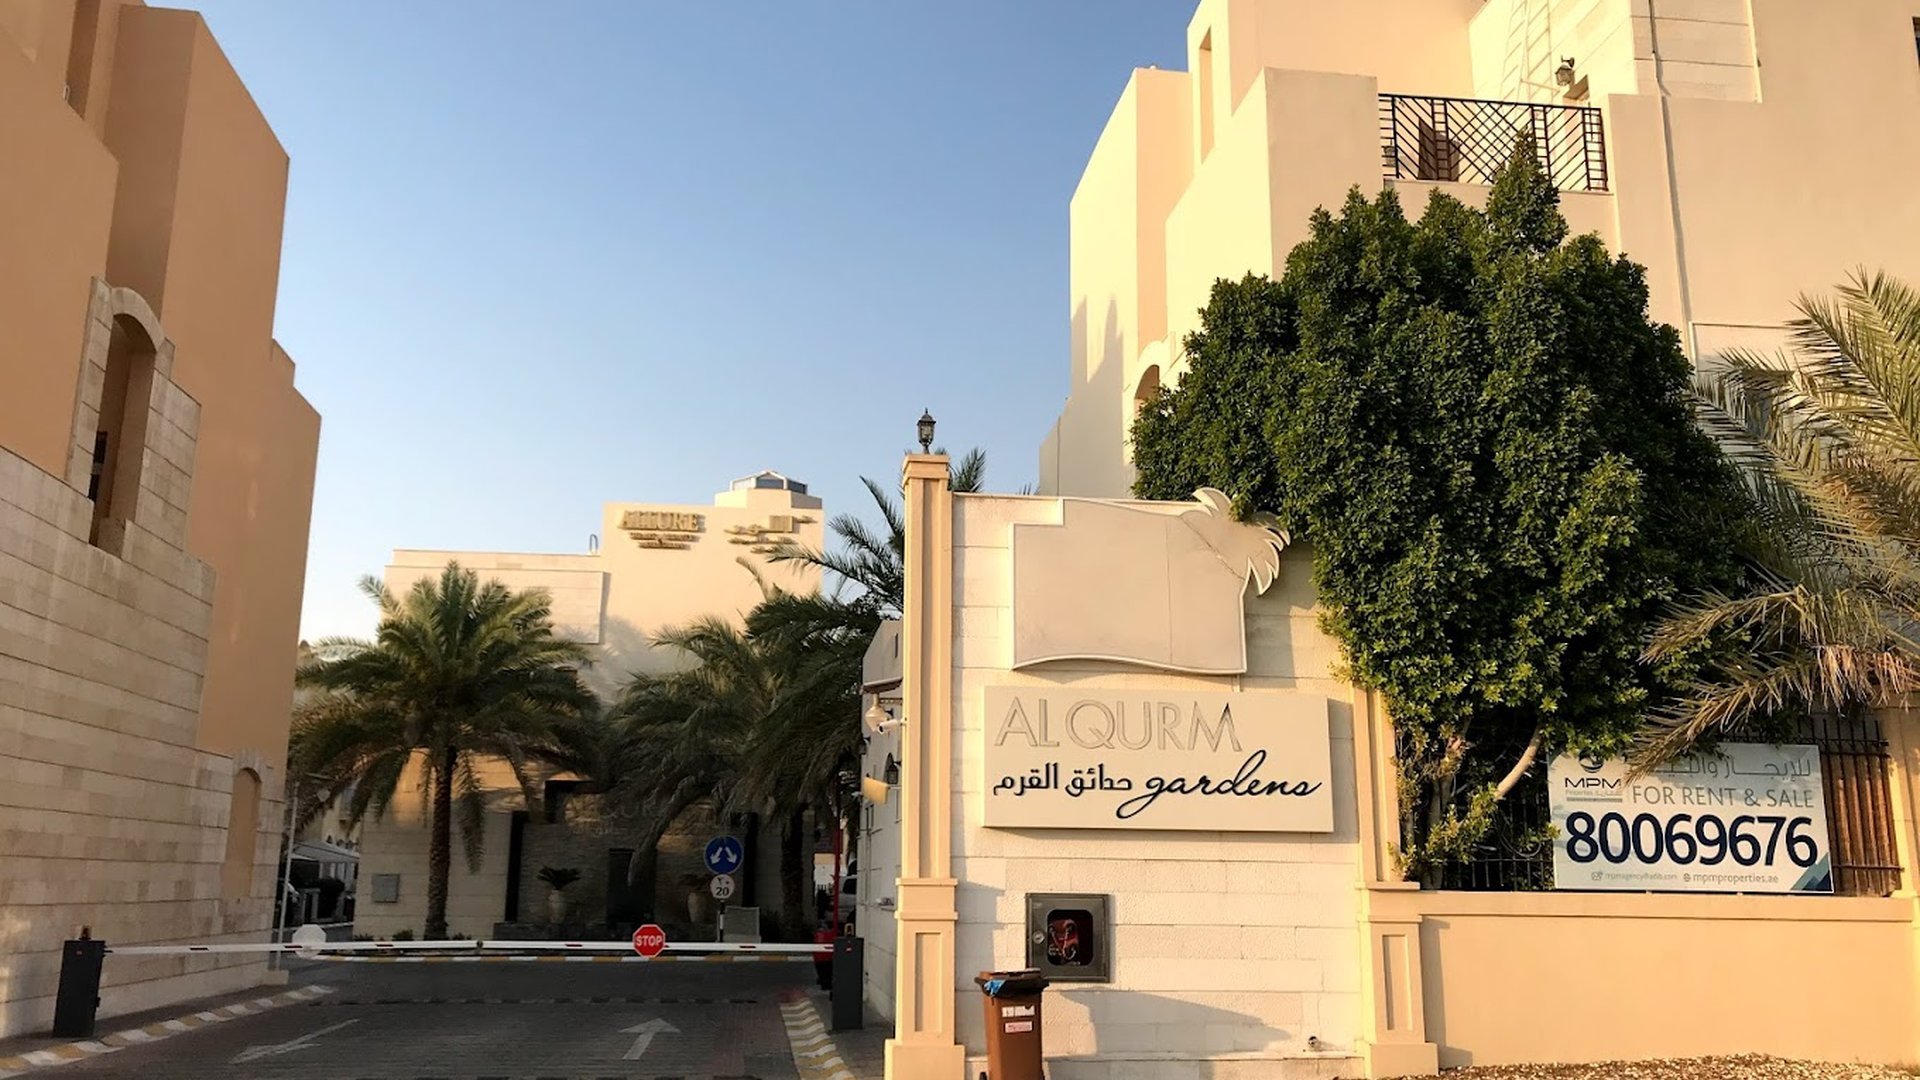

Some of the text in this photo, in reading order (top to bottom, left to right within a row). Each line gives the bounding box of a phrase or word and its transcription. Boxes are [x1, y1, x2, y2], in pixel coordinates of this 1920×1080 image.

[994, 696, 1243, 752] AL QURM
[993, 762, 1133, 797] حدائق القرم
[1116, 749, 1322, 819] gardens
[1565, 777, 1621, 789] MPM
[1633, 785, 1675, 805] FOR
[1683, 787, 1736, 807] RENT
[1744, 788, 1762, 807] &
[1767, 789, 1814, 808] SALE
[1565, 811, 1817, 868] 80069676
[1693, 872, 1779, 885] mpmproperties.ae
[715, 886, 730, 897] 20
[635, 934, 663, 947] STOP
